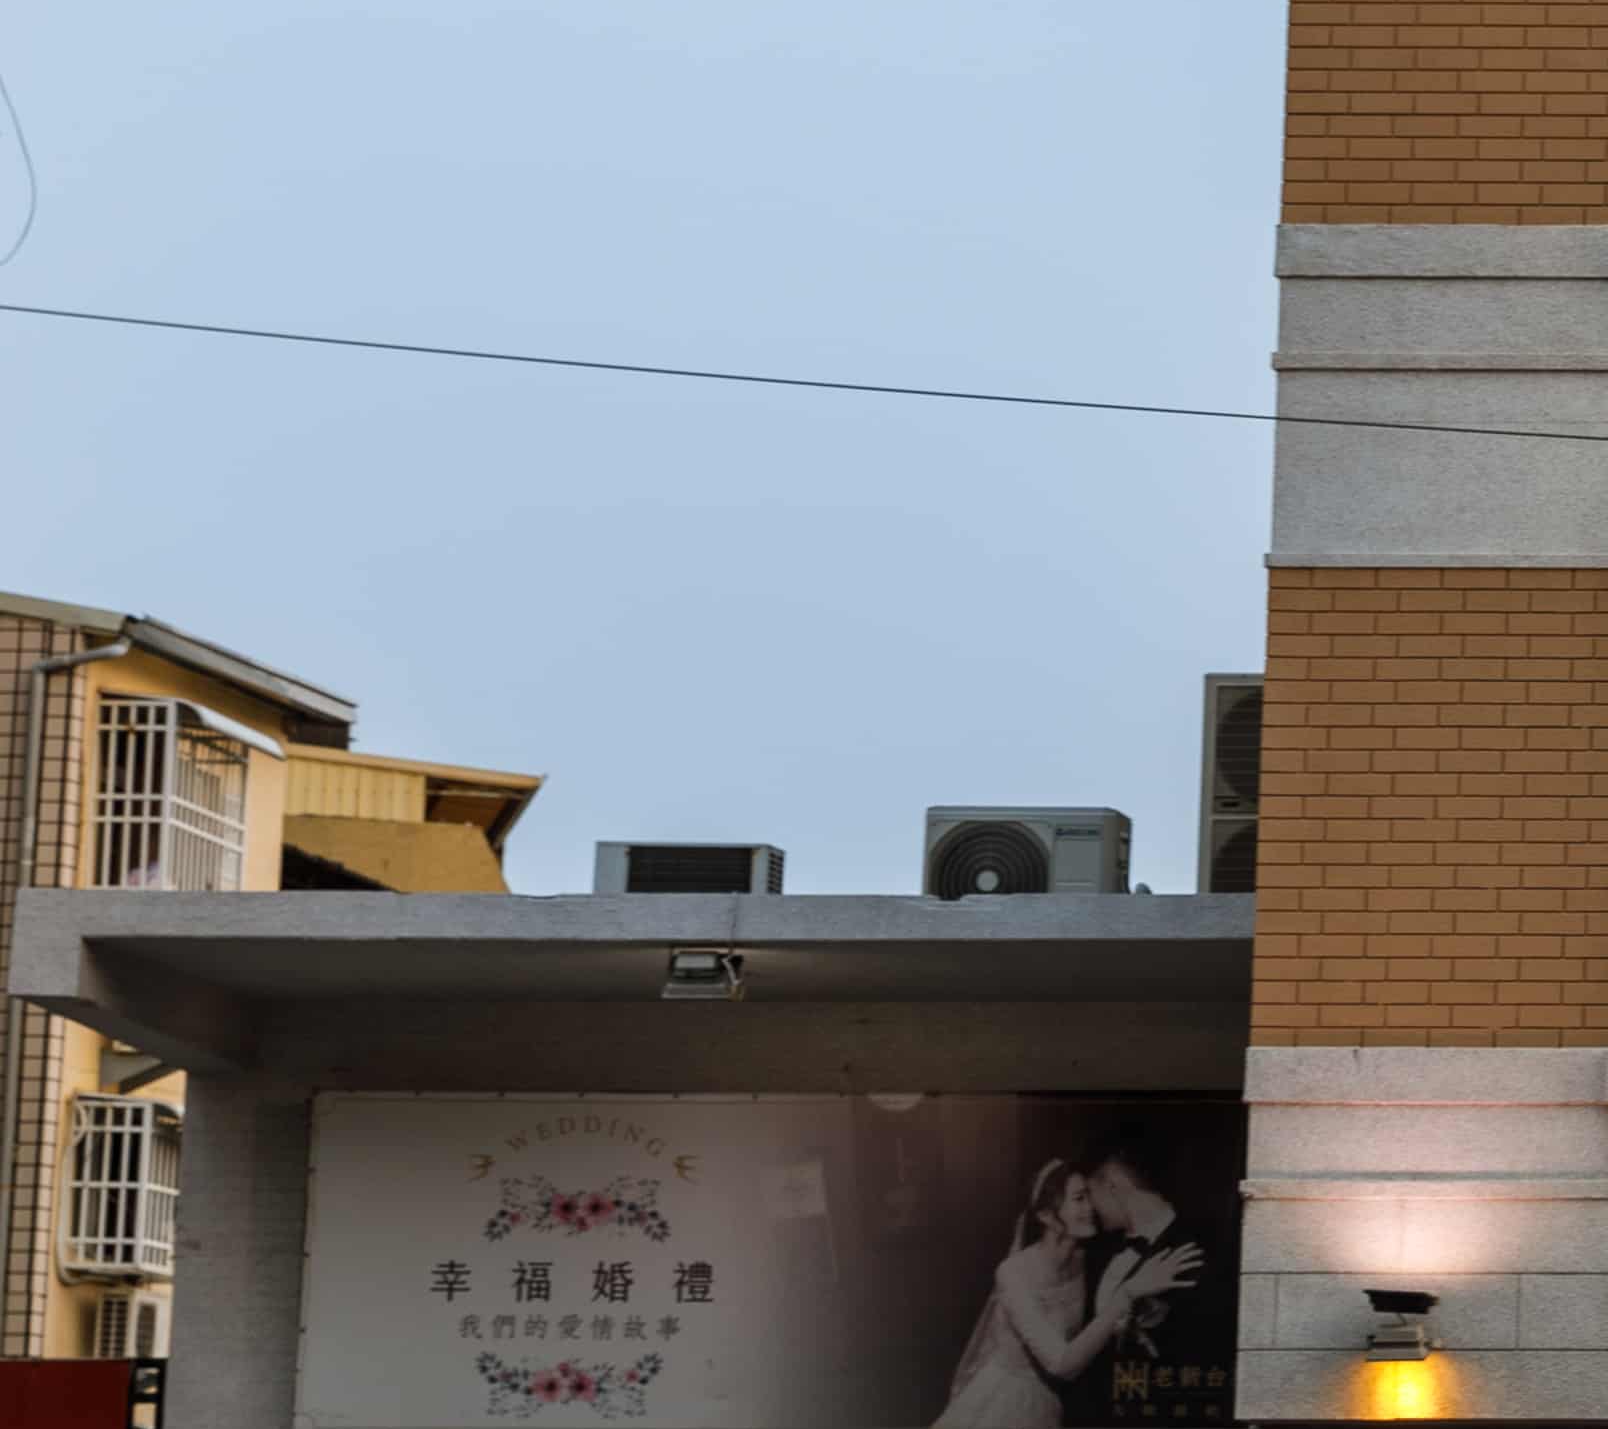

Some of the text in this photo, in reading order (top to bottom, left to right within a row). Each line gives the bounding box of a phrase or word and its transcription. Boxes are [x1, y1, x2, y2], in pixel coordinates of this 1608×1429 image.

[504, 1115, 666, 1157] WEDDING
[429, 1260, 714, 1302] 幸福婚禮
[459, 1314, 681, 1340] 我們的愛情故事
